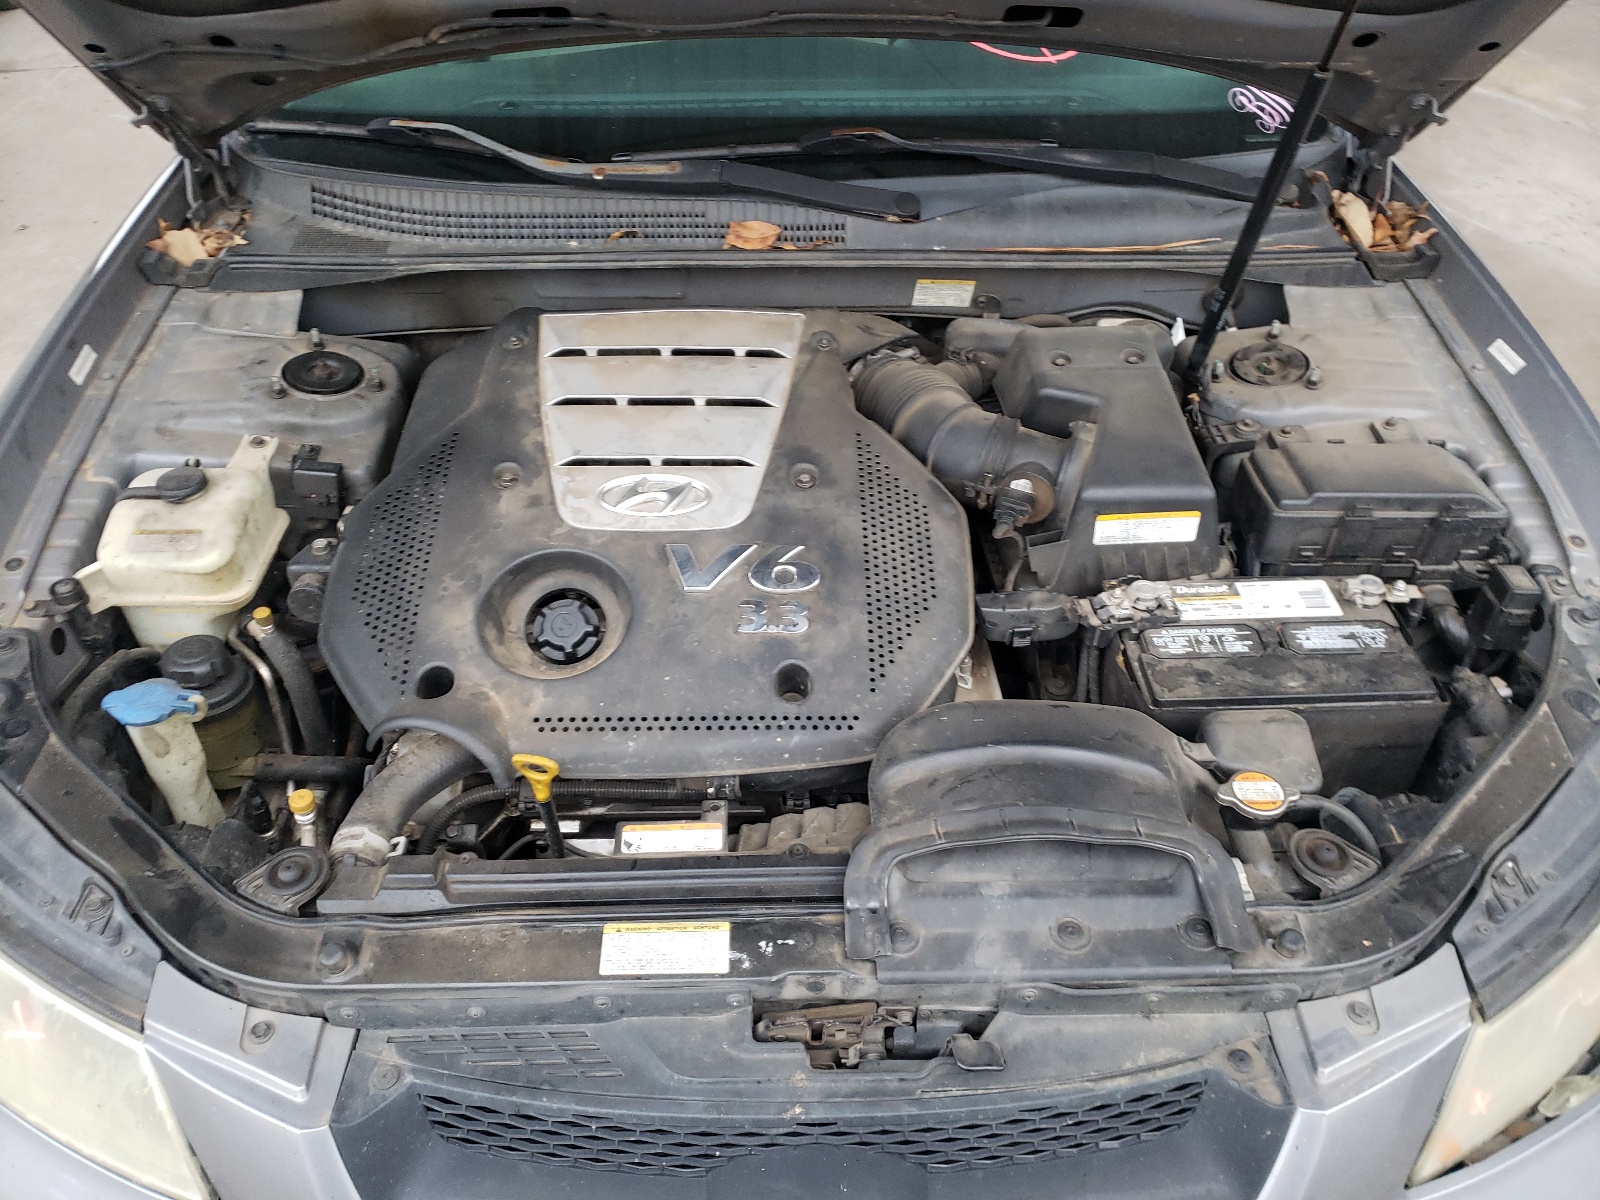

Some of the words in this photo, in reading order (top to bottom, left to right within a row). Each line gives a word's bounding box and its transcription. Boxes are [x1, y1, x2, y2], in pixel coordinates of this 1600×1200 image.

[665, 544, 821, 593] V6
[1172, 584, 1230, 595] Duralast
[737, 600, 810, 634] 3.3
